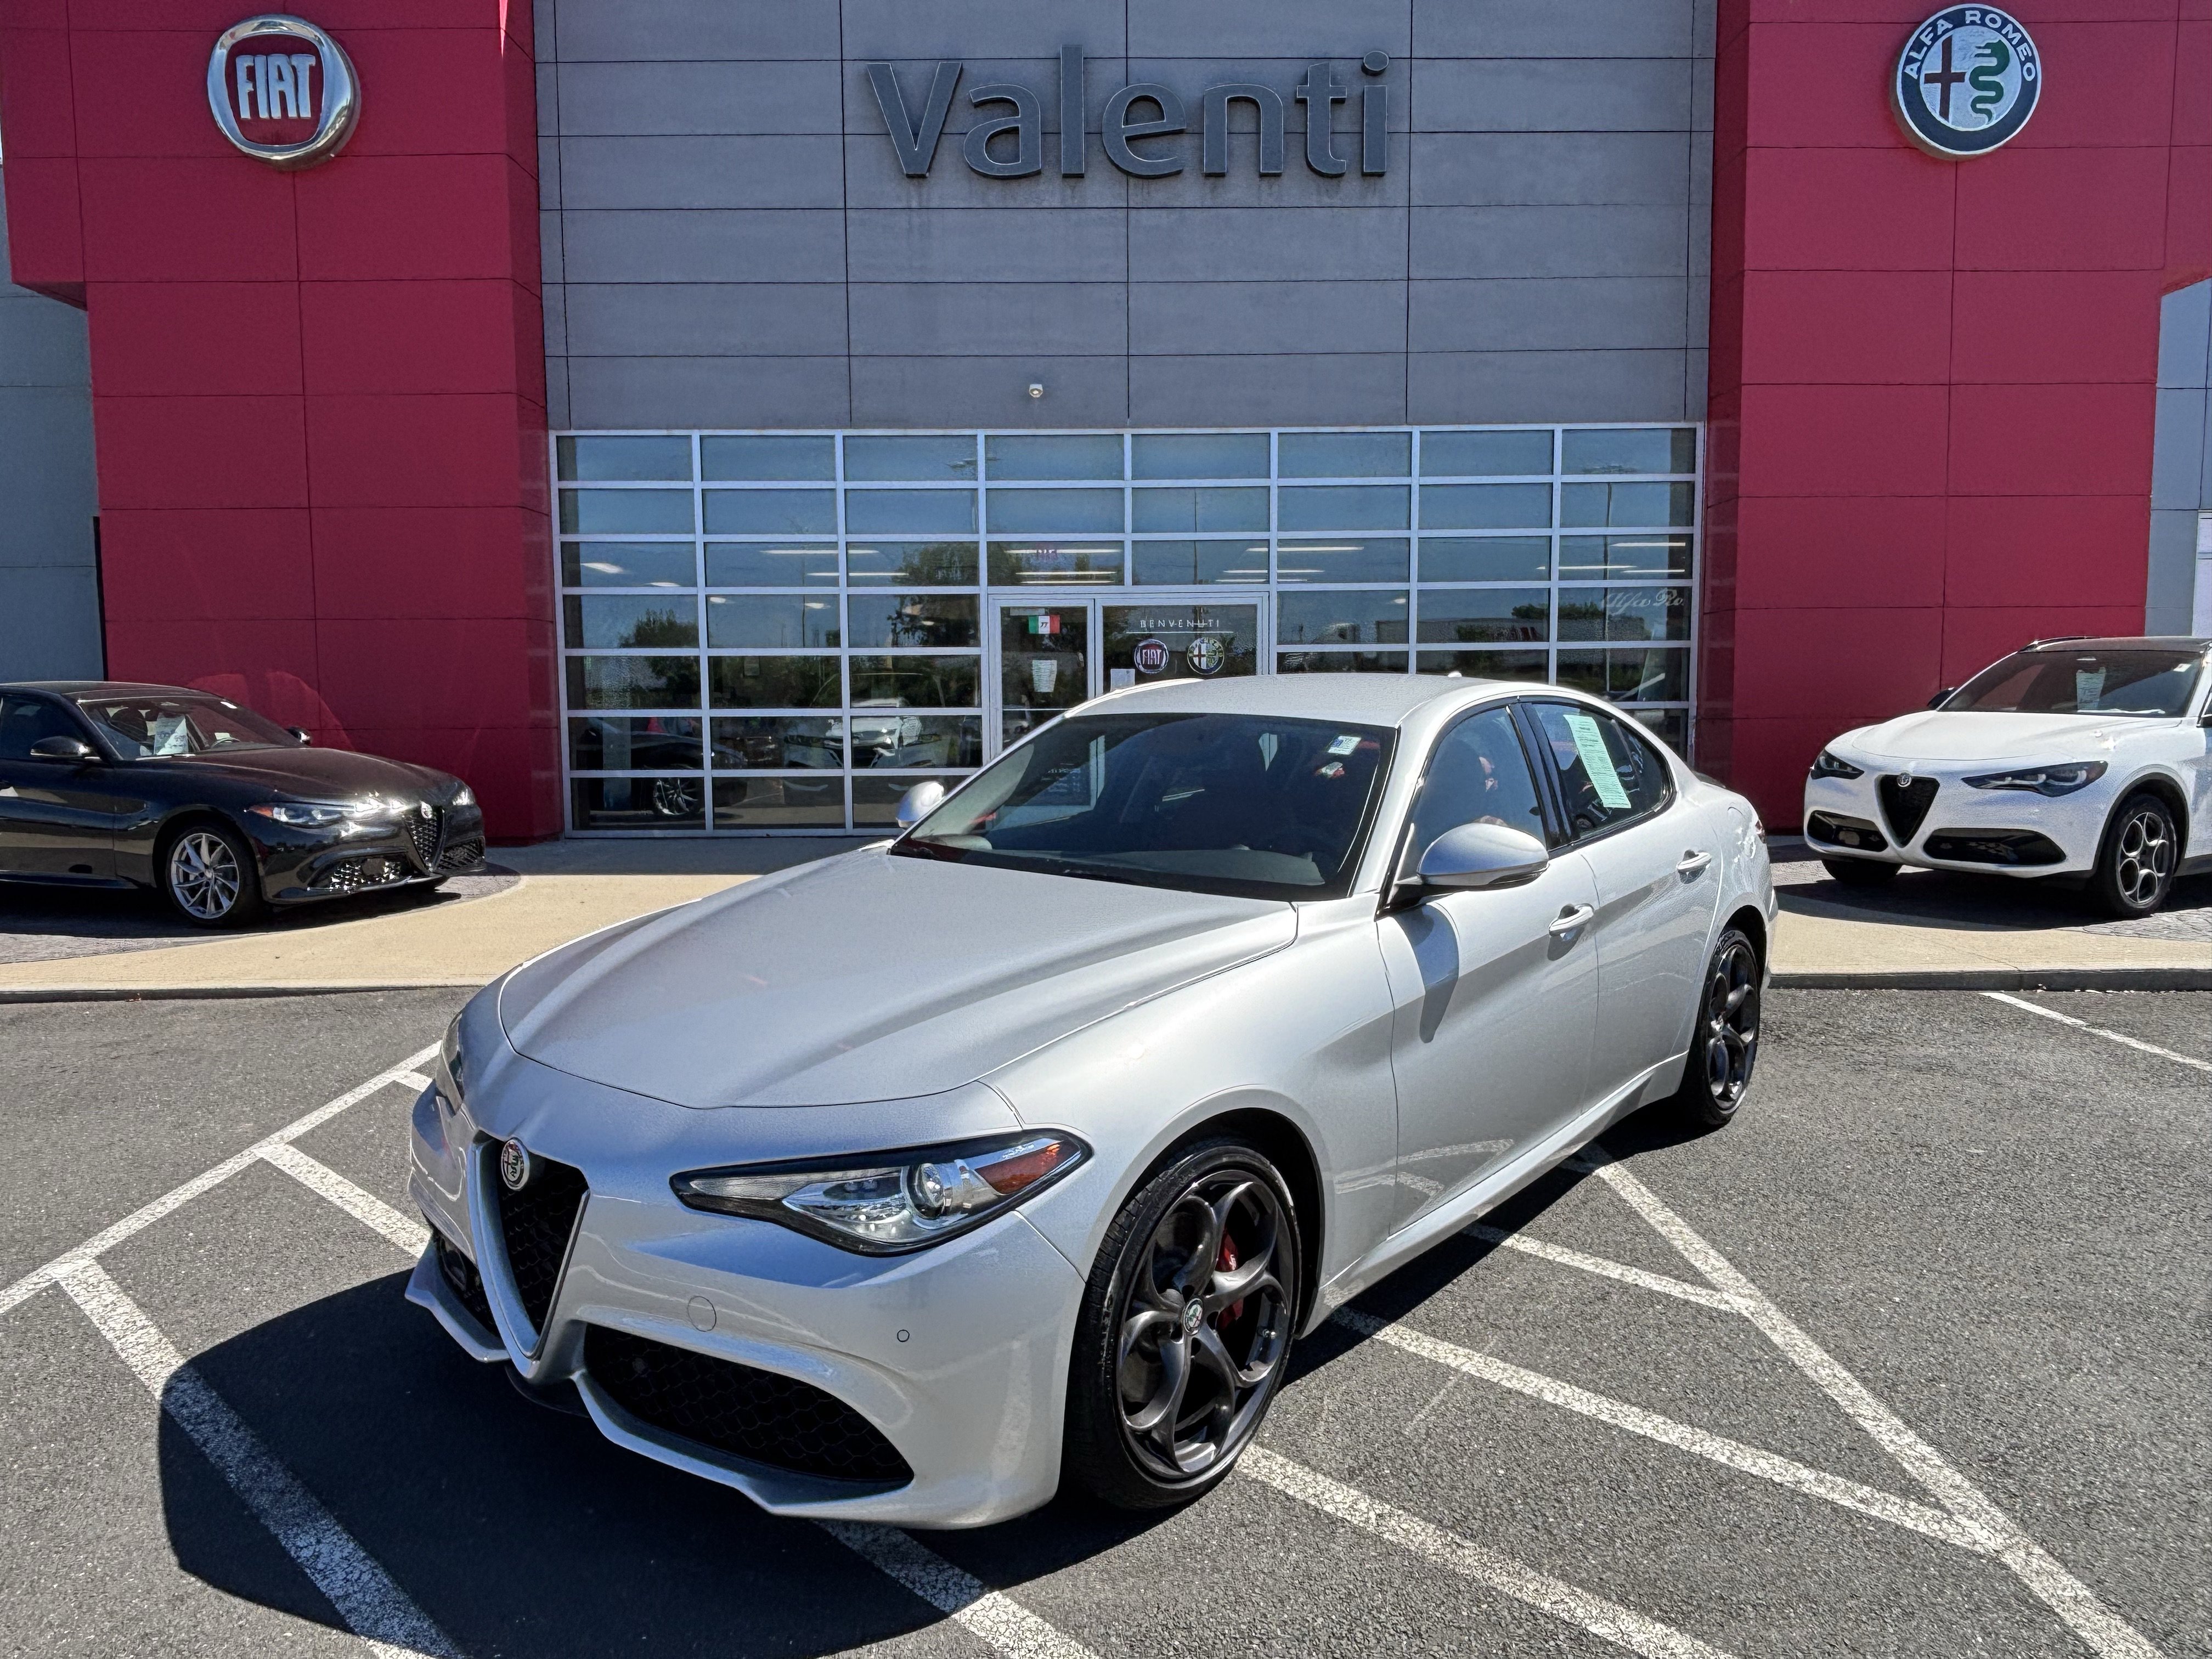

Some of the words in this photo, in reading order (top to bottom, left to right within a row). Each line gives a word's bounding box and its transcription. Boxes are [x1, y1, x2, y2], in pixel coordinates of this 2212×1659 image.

[1904, 19, 1954, 80] ALFA
[1965, 10, 2036, 82] ROMEO
[236, 53, 316, 120] FIAT
[866, 45, 1390, 178] Valenti
[1139, 619, 1219, 628] BENVENUTI
[1142, 649, 1162, 665] FIAT
